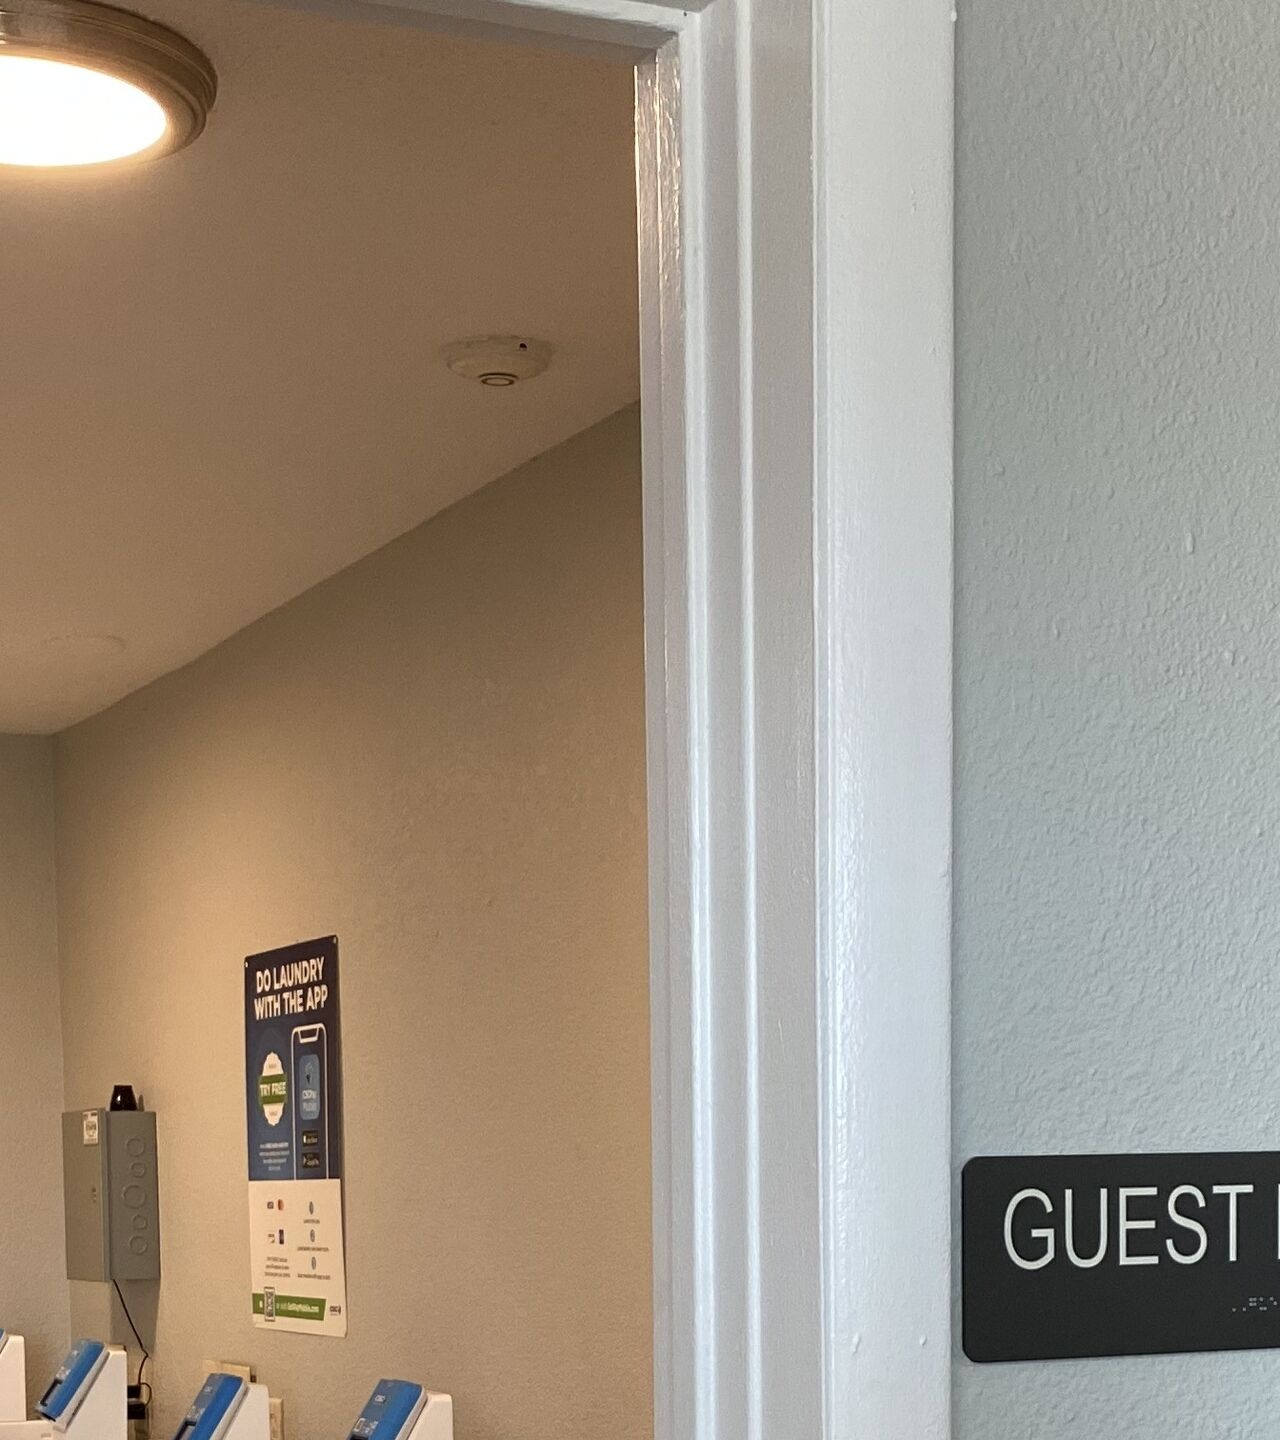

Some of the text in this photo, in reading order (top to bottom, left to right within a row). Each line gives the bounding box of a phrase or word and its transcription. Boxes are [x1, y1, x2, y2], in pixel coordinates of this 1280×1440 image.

[256, 956, 324, 993] DO LAUNDRY
[254, 984, 328, 1020] WITH THE APP
[260, 1082, 287, 1097] TRY FREE
[1003, 1184, 1253, 1271] GUEST
